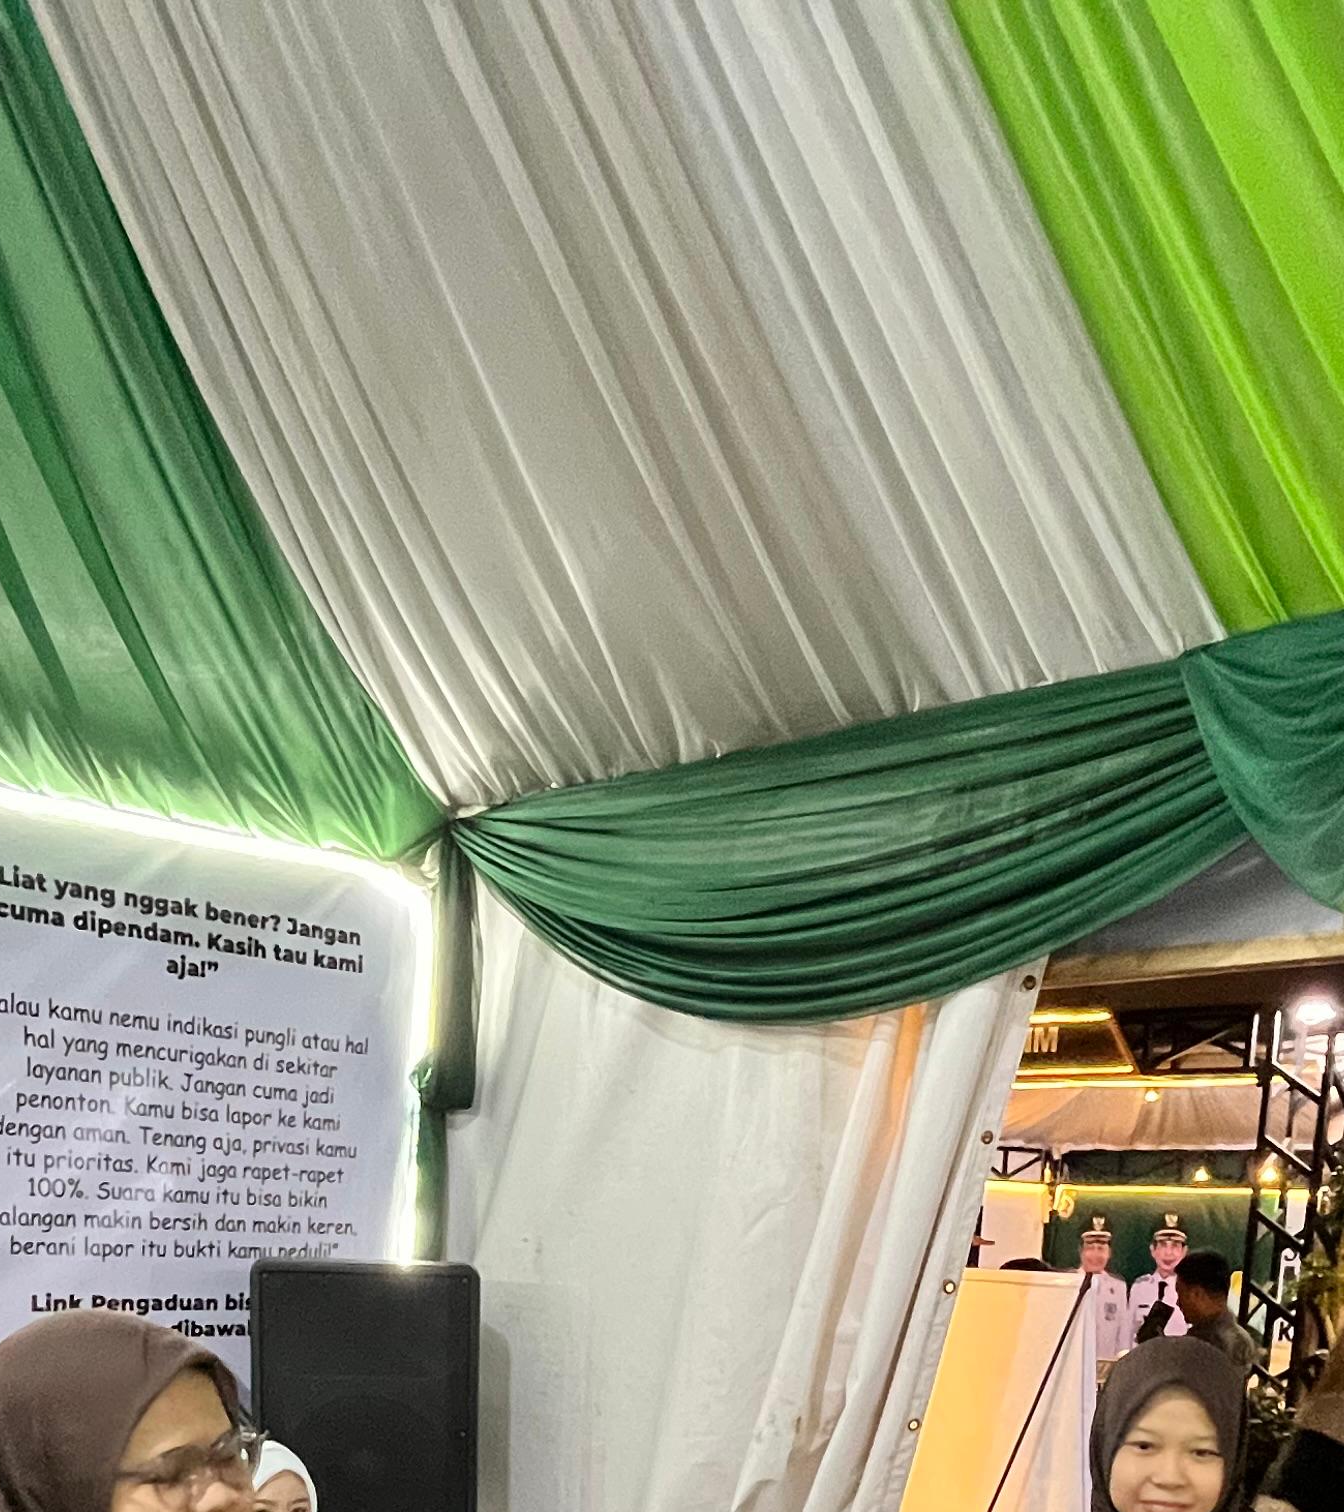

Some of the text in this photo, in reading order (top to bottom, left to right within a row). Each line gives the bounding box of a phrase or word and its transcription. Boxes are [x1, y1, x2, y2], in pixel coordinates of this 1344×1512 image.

[54, 879, 117, 907] yang
[124, 891, 199, 919] nggak
[205, 902, 281, 932] bener?
[286, 917, 361, 946] Jangan
[73, 910, 200, 950] dipendam.
[207, 932, 267, 959] Kasih
[273, 944, 307, 965] tau
[313, 949, 364, 974] kami
[49, 998, 102, 1025] kamu
[109, 1011, 160, 1031] nemu
[167, 1013, 239, 1039] indikasi
[245, 1027, 296, 1051] pungli
[302, 1034, 340, 1052] atau
[345, 1035, 368, 1055] hal
[24, 1026, 338, 1078] hal yang mencurigakan di sekitar
[27, 1056, 334, 1108] layanan publik. Jangan cuma jadi
[16, 1092, 341, 1131] penonton. Kamu bisa lapor ke kami
[73, 1127, 131, 1144] aman.
[139, 1126, 206, 1154] Tenang
[253, 1136, 310, 1158] privasi
[315, 1138, 357, 1159] kamu
[7, 1147, 344, 1188] itu prioritas. Kami jaga rapet-rapet
[28, 1177, 327, 1208] 100%. Suara kamu itu bisa bikin
[84, 1209, 141, 1229] makin
[149, 1211, 208, 1231] bersih
[215, 1213, 246, 1232] dan
[252, 1216, 301, 1234] makin
[10, 1234, 76, 1255] berani
[85, 1236, 134, 1262] lapor
[142, 1239, 167, 1257] itu
[174, 1239, 221, 1258] bukti
[228, 1241, 272, 1259] kamu
[31, 1293, 83, 1312] Link
[92, 1294, 218, 1315] Pengaduan
[171, 1319, 251, 1337] dibawa
